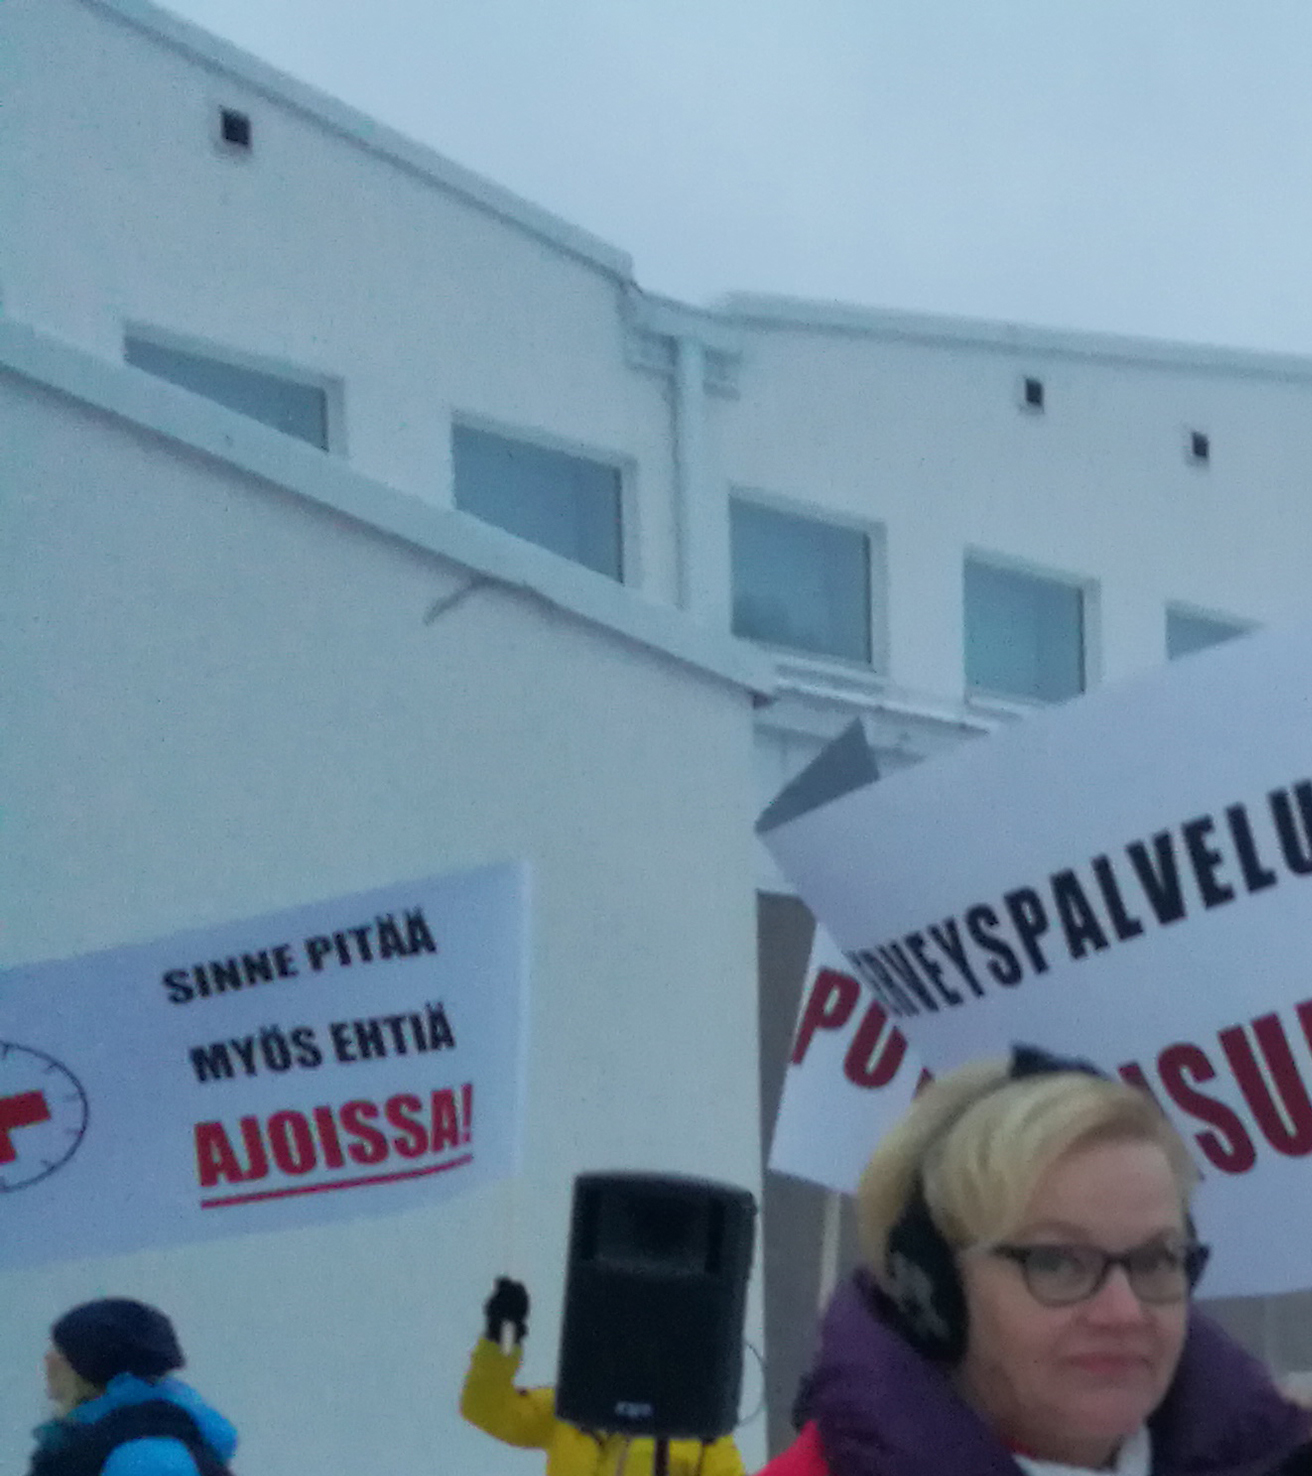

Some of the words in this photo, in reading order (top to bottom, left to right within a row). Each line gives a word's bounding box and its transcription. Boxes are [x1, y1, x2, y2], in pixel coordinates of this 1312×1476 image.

[162, 943, 300, 1004] SINNE
[306, 907, 437, 973] PITÄÄ
[190, 1024, 323, 1083] MYÖS
[329, 1002, 456, 1063] EHTIÄ
[193, 1084, 474, 1188] AJOISSA!
